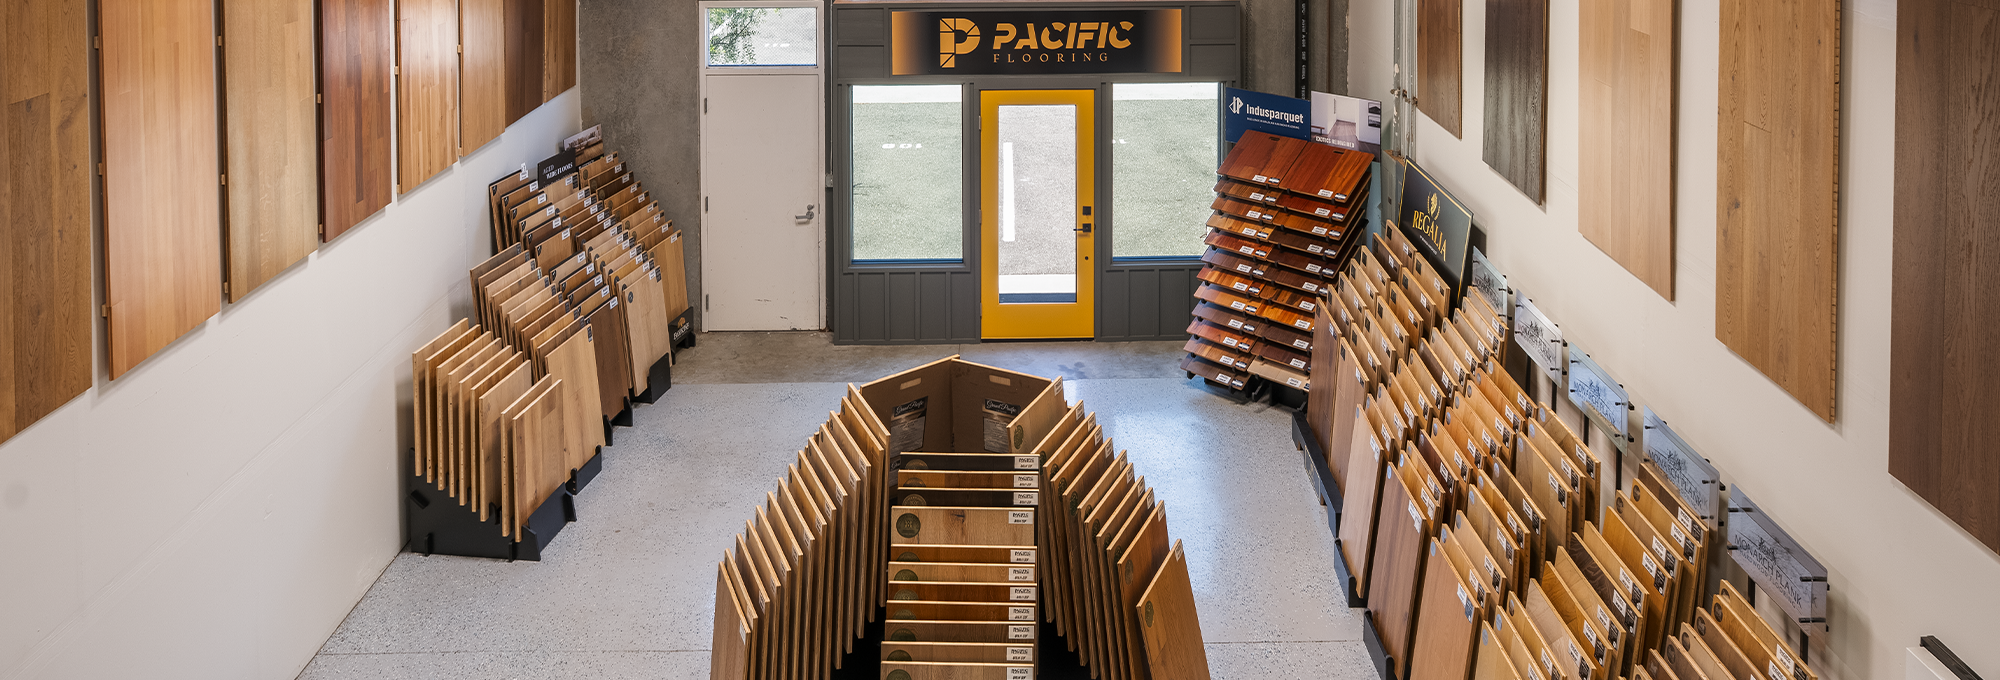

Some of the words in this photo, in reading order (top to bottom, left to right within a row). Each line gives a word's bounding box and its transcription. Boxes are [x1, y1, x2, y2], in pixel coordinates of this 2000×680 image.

[993, 21, 1134, 49] PACIFIC
[993, 53, 1108, 63] FLOORING
[1246, 103, 1304, 124] Indusparquet
[1412, 210, 1447, 262] REGALIA
[1649, 449, 1681, 484] MONARCH
[1681, 475, 1702, 508] PLANK
[1734, 534, 1774, 575] MONARCH
[1775, 570, 1802, 608] PLANK
